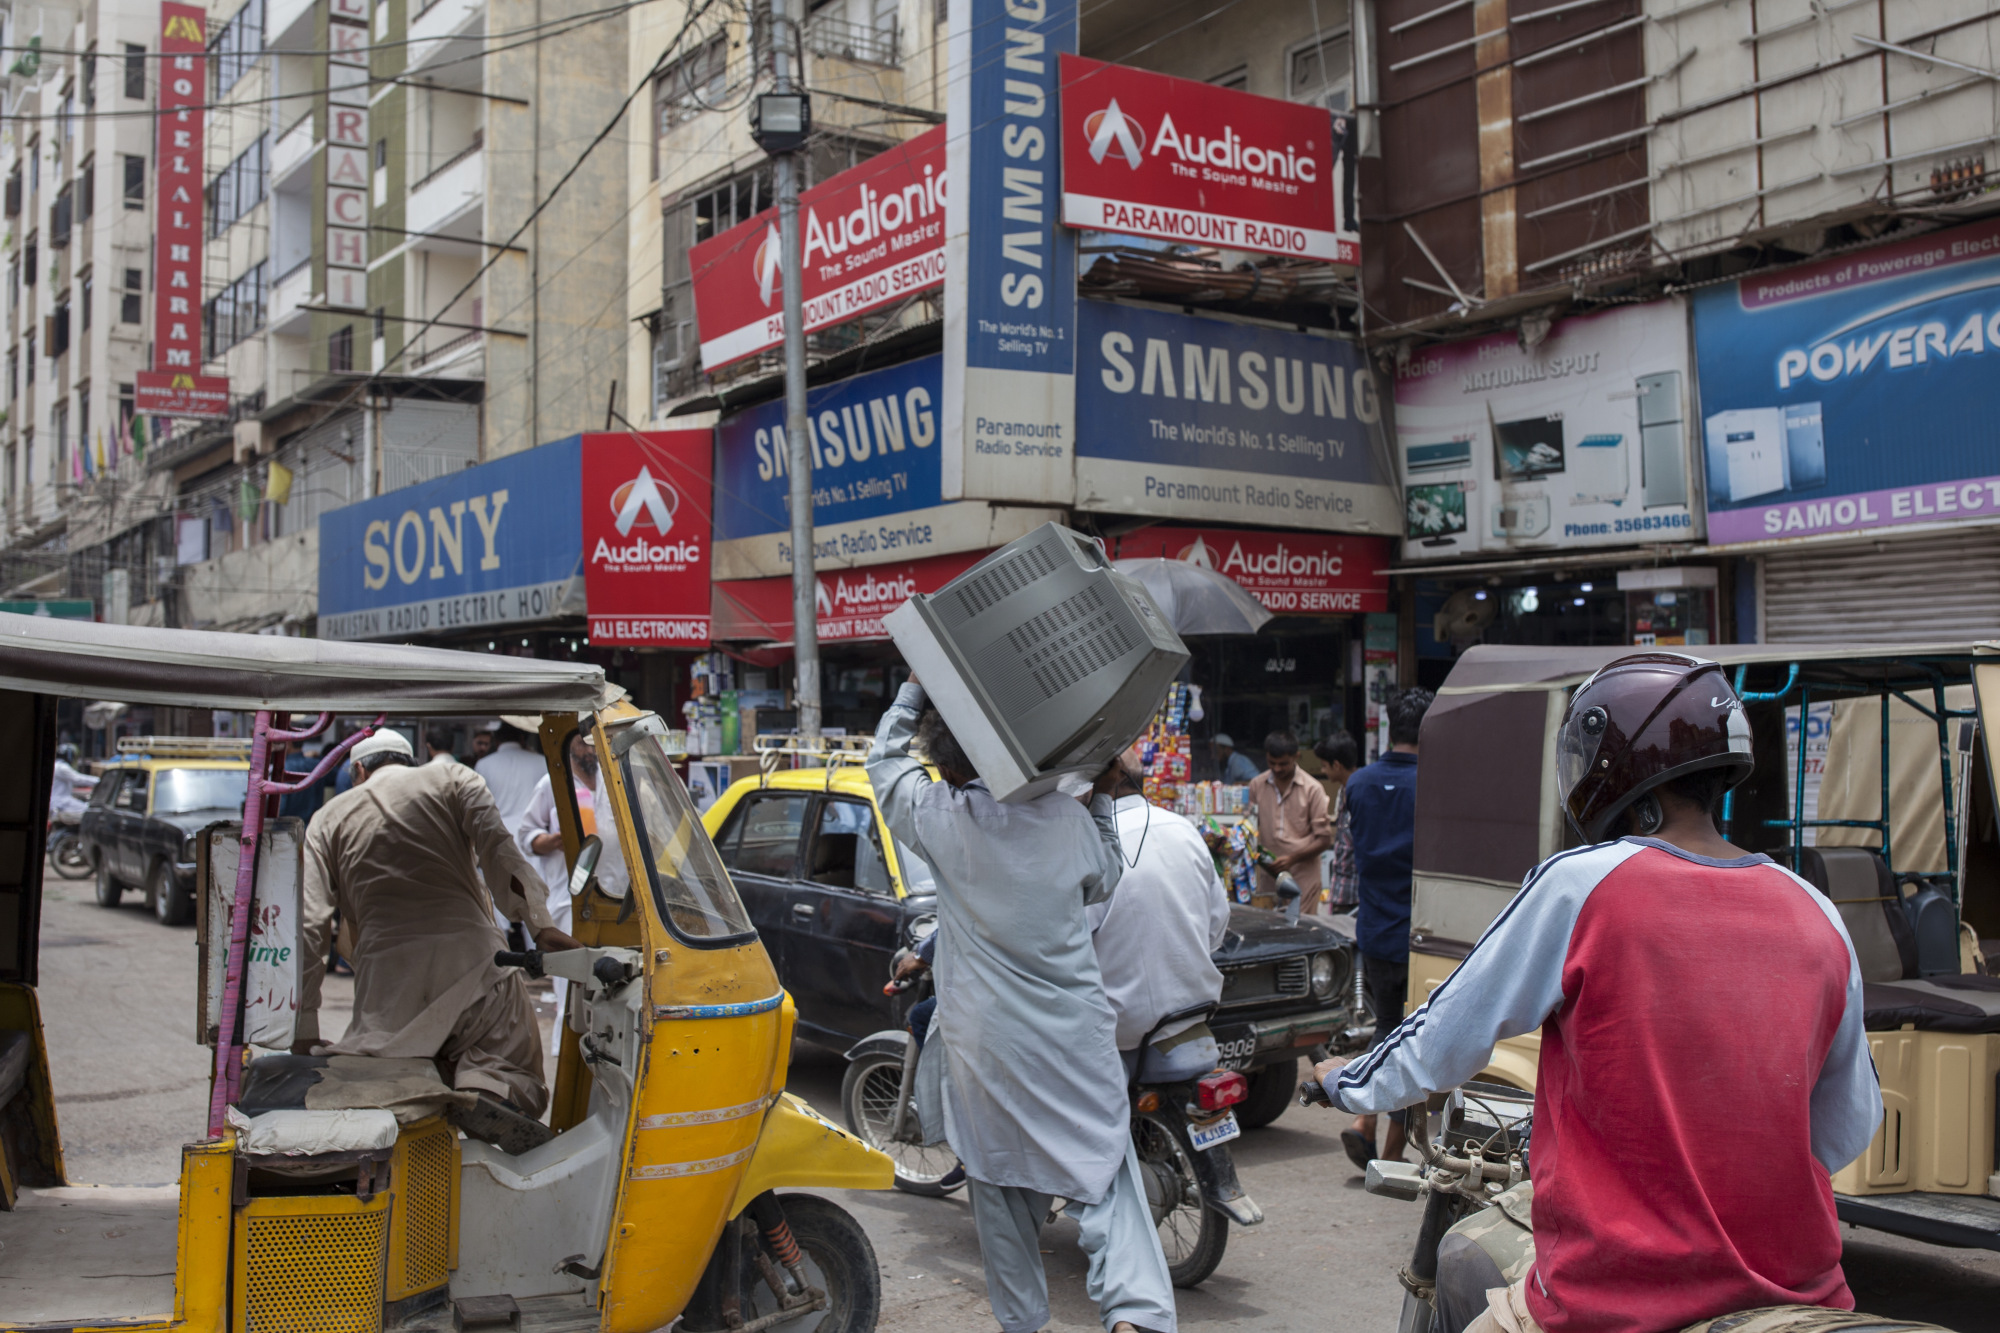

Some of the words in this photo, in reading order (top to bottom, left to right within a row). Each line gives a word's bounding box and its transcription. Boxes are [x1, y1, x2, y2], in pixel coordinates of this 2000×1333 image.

[172, 53, 194, 174] HOTEL
[1151, 112, 1316, 183] Audionic
[1170, 162, 1198, 179] The
[1202, 165, 1247, 187] Sound
[1251, 175, 1300, 196] Master
[1103, 203, 1238, 242] PARAMOUNT
[1244, 224, 1306, 252] RADIO
[819, 262, 843, 282] The
[845, 243, 887, 272] Sound
[891, 220, 941, 254] Master
[1758, 271, 1832, 301] Products
[1835, 267, 1853, 284] of
[1857, 248, 1946, 279] Powerage
[167, 245, 191, 368] HARAM
[845, 274, 888, 311] RADIO
[978, 320, 998, 334] The
[998, 321, 1038, 338] World's
[1039, 326, 1056, 339] No.
[1057, 328, 1064, 340] 1
[998, 339, 1033, 357] Selling
[1035, 341, 1049, 355] TV
[1101, 330, 1380, 425] SAMSUNG
[1398, 355, 1445, 380] Haier
[1463, 361, 1549, 394] NATIONAL
[1549, 352, 1600, 380] SPOT
[976, 417, 1062, 439] Paramount
[1149, 419, 1178, 441] The
[1181, 422, 1236, 448] World's
[1239, 431, 1263, 450] No.
[1266, 433, 1276, 450] 1
[1279, 435, 1325, 462] Selling
[1327, 440, 1345, 459] TV
[976, 439, 1012, 456] Radio
[1015, 440, 1063, 458] Service
[857, 477, 893, 501] Selling
[892, 472, 908, 491] TV
[1144, 475, 1242, 505] Paramount
[1246, 484, 1290, 509] Radio
[1294, 489, 1353, 515] Service
[1564, 519, 1612, 537] Phone:
[1764, 497, 1879, 535] SAMOL
[364, 488, 509, 591] SONY
[592, 537, 701, 566] Audionic
[841, 529, 878, 555] Radio
[879, 521, 933, 551] Service
[603, 563, 620, 573] The
[622, 563, 653, 573] Sound
[654, 563, 687, 573] Master
[1223, 540, 1342, 577] Audionic
[834, 573, 916, 607] Audionic
[1236, 574, 1255, 586] The
[1257, 575, 1289, 587] Sound
[1293, 576, 1328, 588] Master
[326, 609, 381, 639] PAKISTAN
[387, 604, 430, 633] RADIO
[438, 593, 507, 628] ELECTRIC
[843, 605, 857, 616] The
[857, 603, 881, 614] Sound
[1300, 592, 1362, 610] SERVICE
[593, 623, 614, 641] ALI
[615, 620, 709, 641] ELECTRONICS
